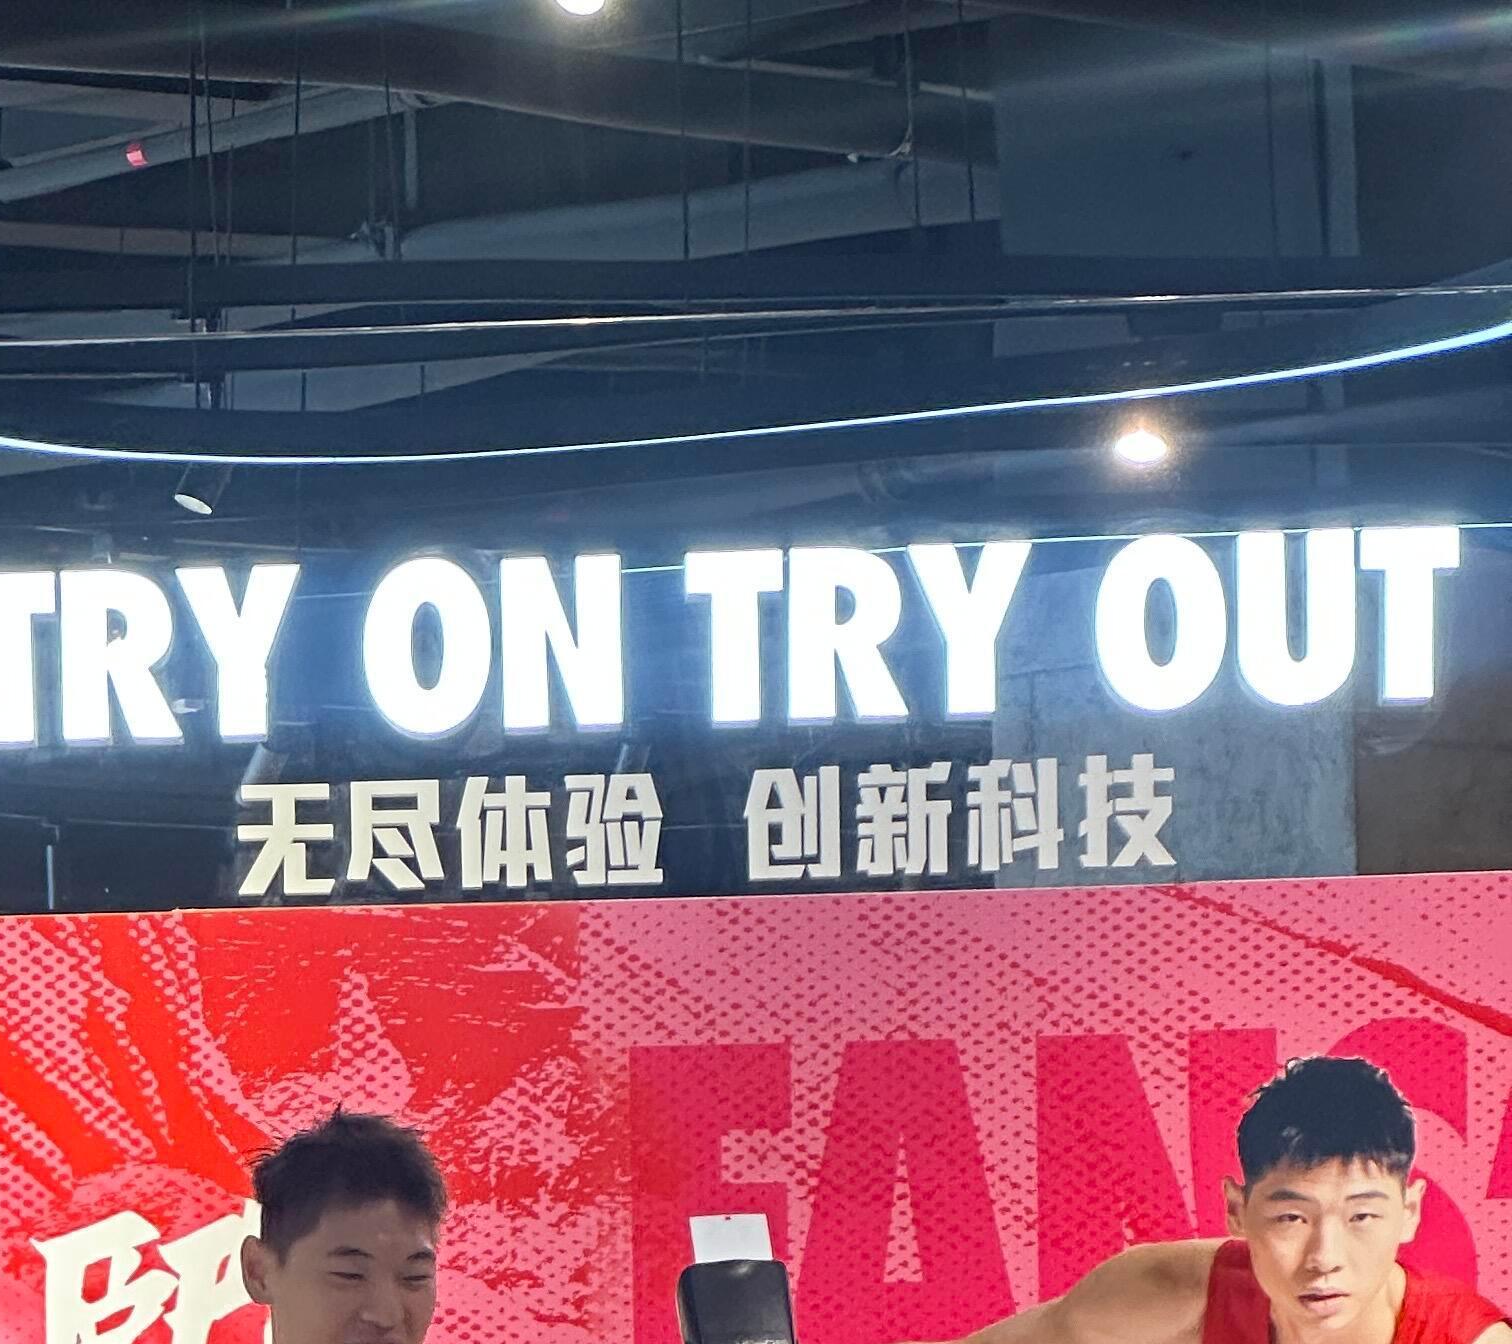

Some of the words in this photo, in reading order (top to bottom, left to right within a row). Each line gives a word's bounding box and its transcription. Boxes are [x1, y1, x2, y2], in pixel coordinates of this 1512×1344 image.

[364, 555, 624, 740] ON
[684, 541, 1032, 729] TRY
[1094, 526, 1460, 713] OUT
[237, 773, 664, 896] 无尽体验
[743, 754, 1177, 881] 创新科技
